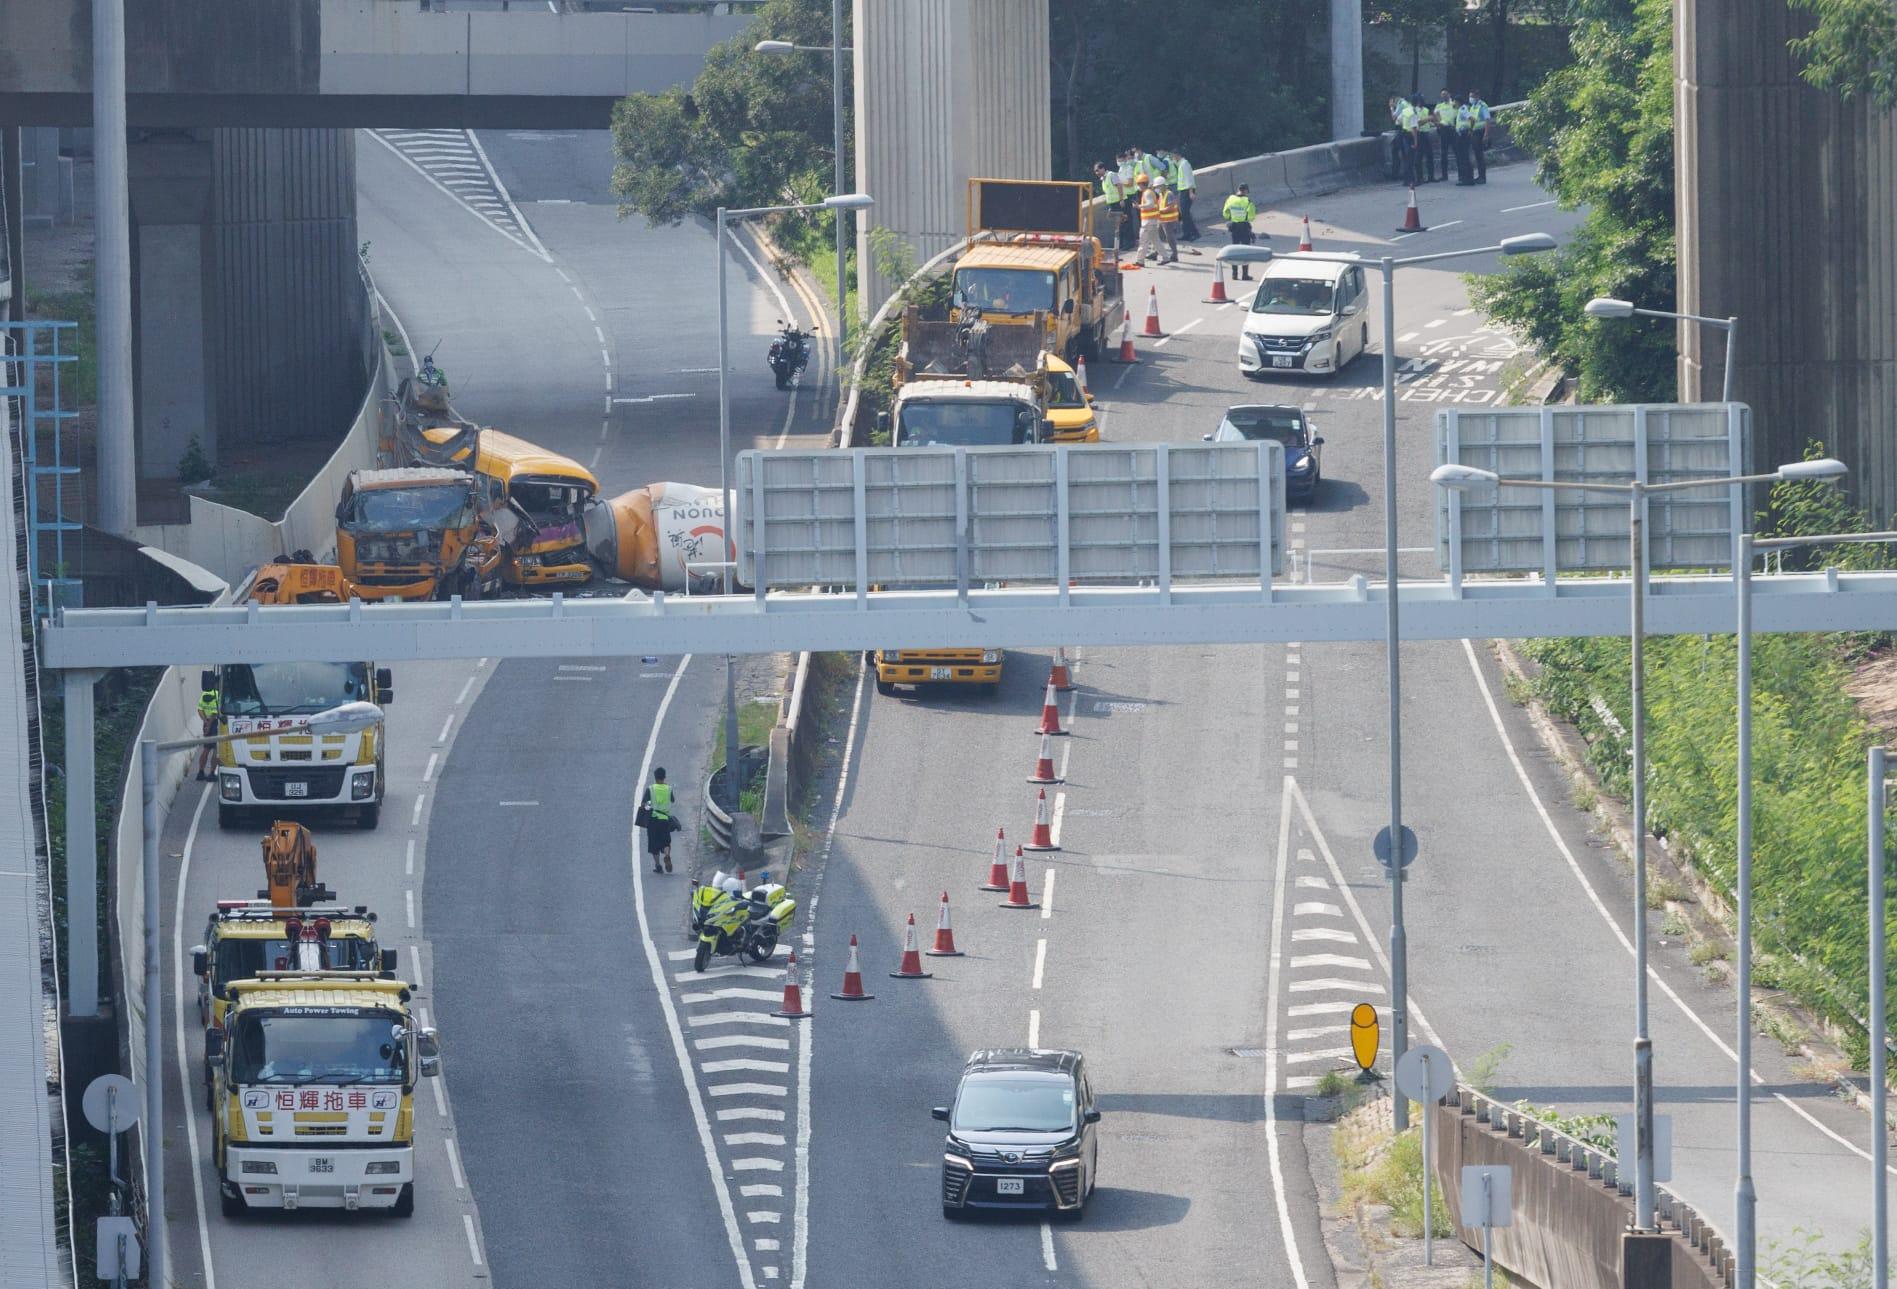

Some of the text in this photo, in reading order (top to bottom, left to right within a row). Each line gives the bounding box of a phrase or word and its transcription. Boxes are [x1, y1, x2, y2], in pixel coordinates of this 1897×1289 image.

[1398, 358, 1503, 374] WAN
[283, 1007, 359, 1016] Auto Power Towing
[275, 1090, 368, 1112] 恒輝拖車
[315, 1158, 328, 1166] BM
[1000, 1181, 1021, 1190] 1273
